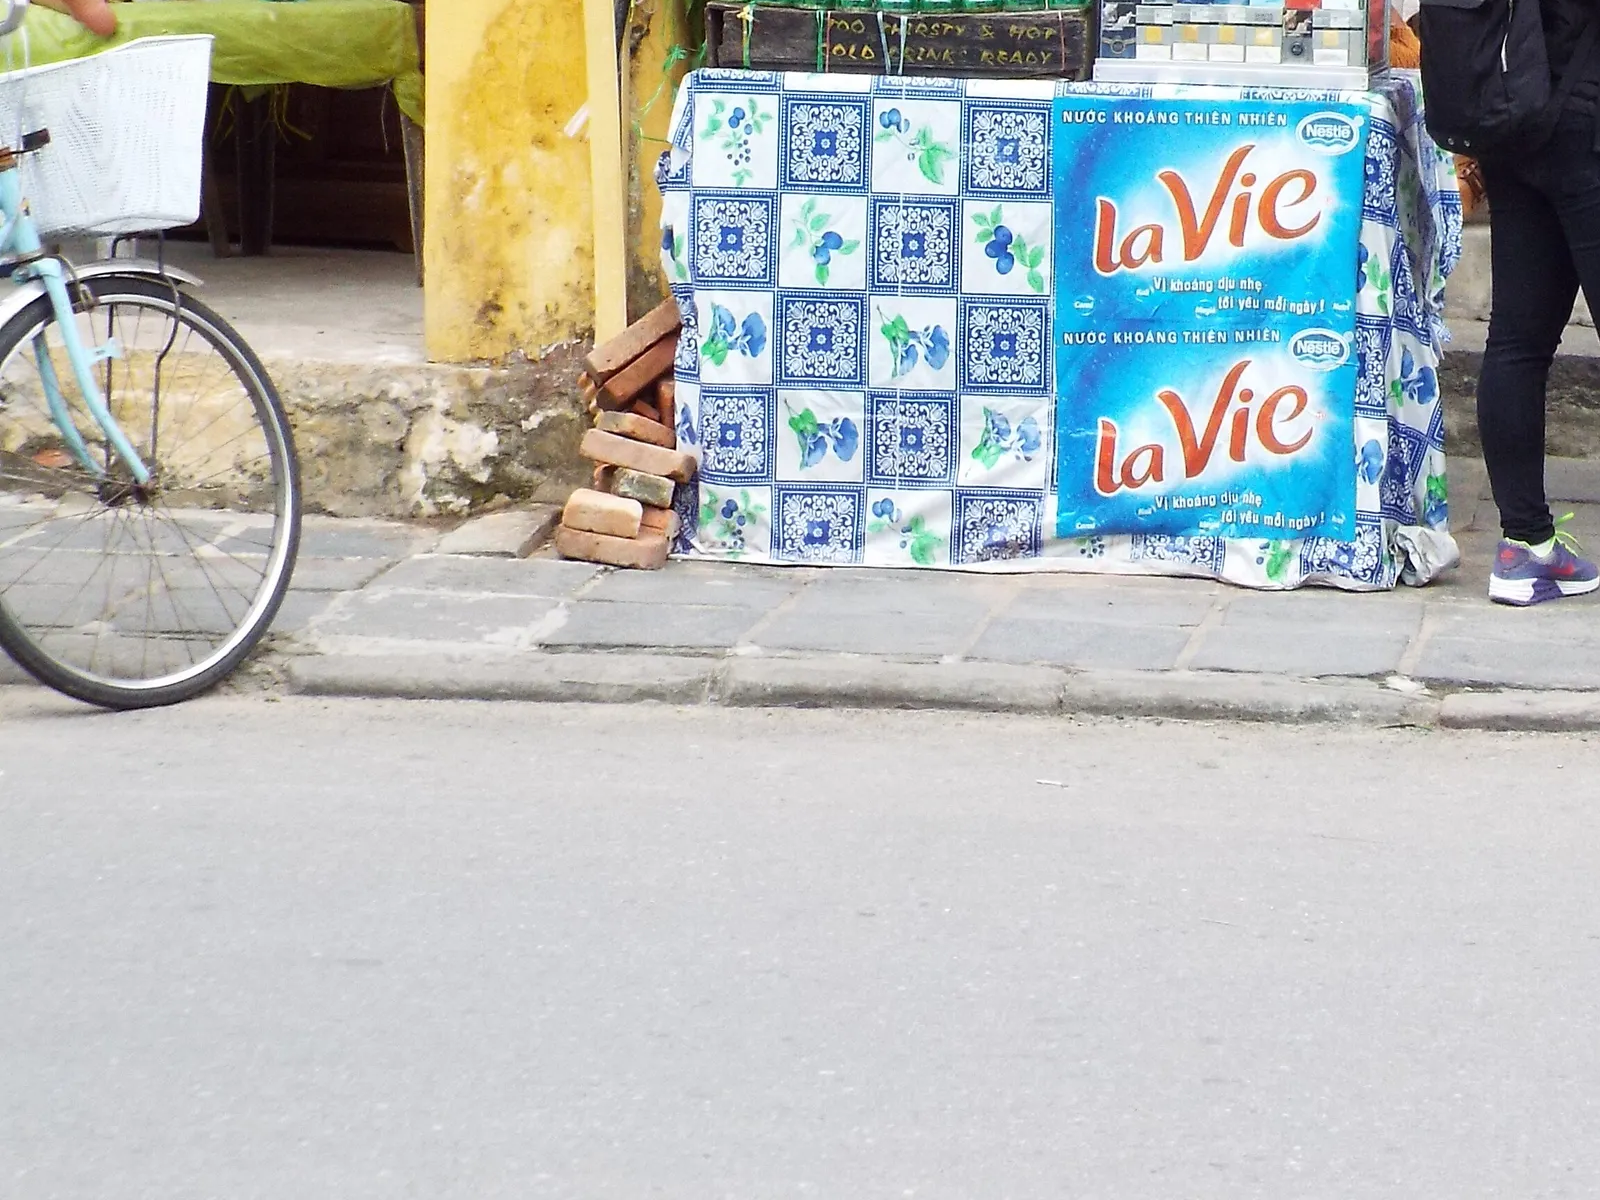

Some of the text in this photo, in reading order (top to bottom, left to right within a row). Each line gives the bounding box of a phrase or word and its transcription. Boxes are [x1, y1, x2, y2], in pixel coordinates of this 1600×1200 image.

[1062, 109, 1288, 127] NƯỚC KHOÁNG THIÊN NHIÊN
[1153, 276, 1263, 293] Vị khoáng dịu nhẹ
[1063, 327, 1282, 345] NƯỚC KHOÁNG THIÊN NHIÊN
[1155, 496, 1168, 511] Vị
[1172, 494, 1217, 509] khoáng
[1220, 491, 1239, 506] dịu
[1242, 491, 1263, 507] nhẹ
